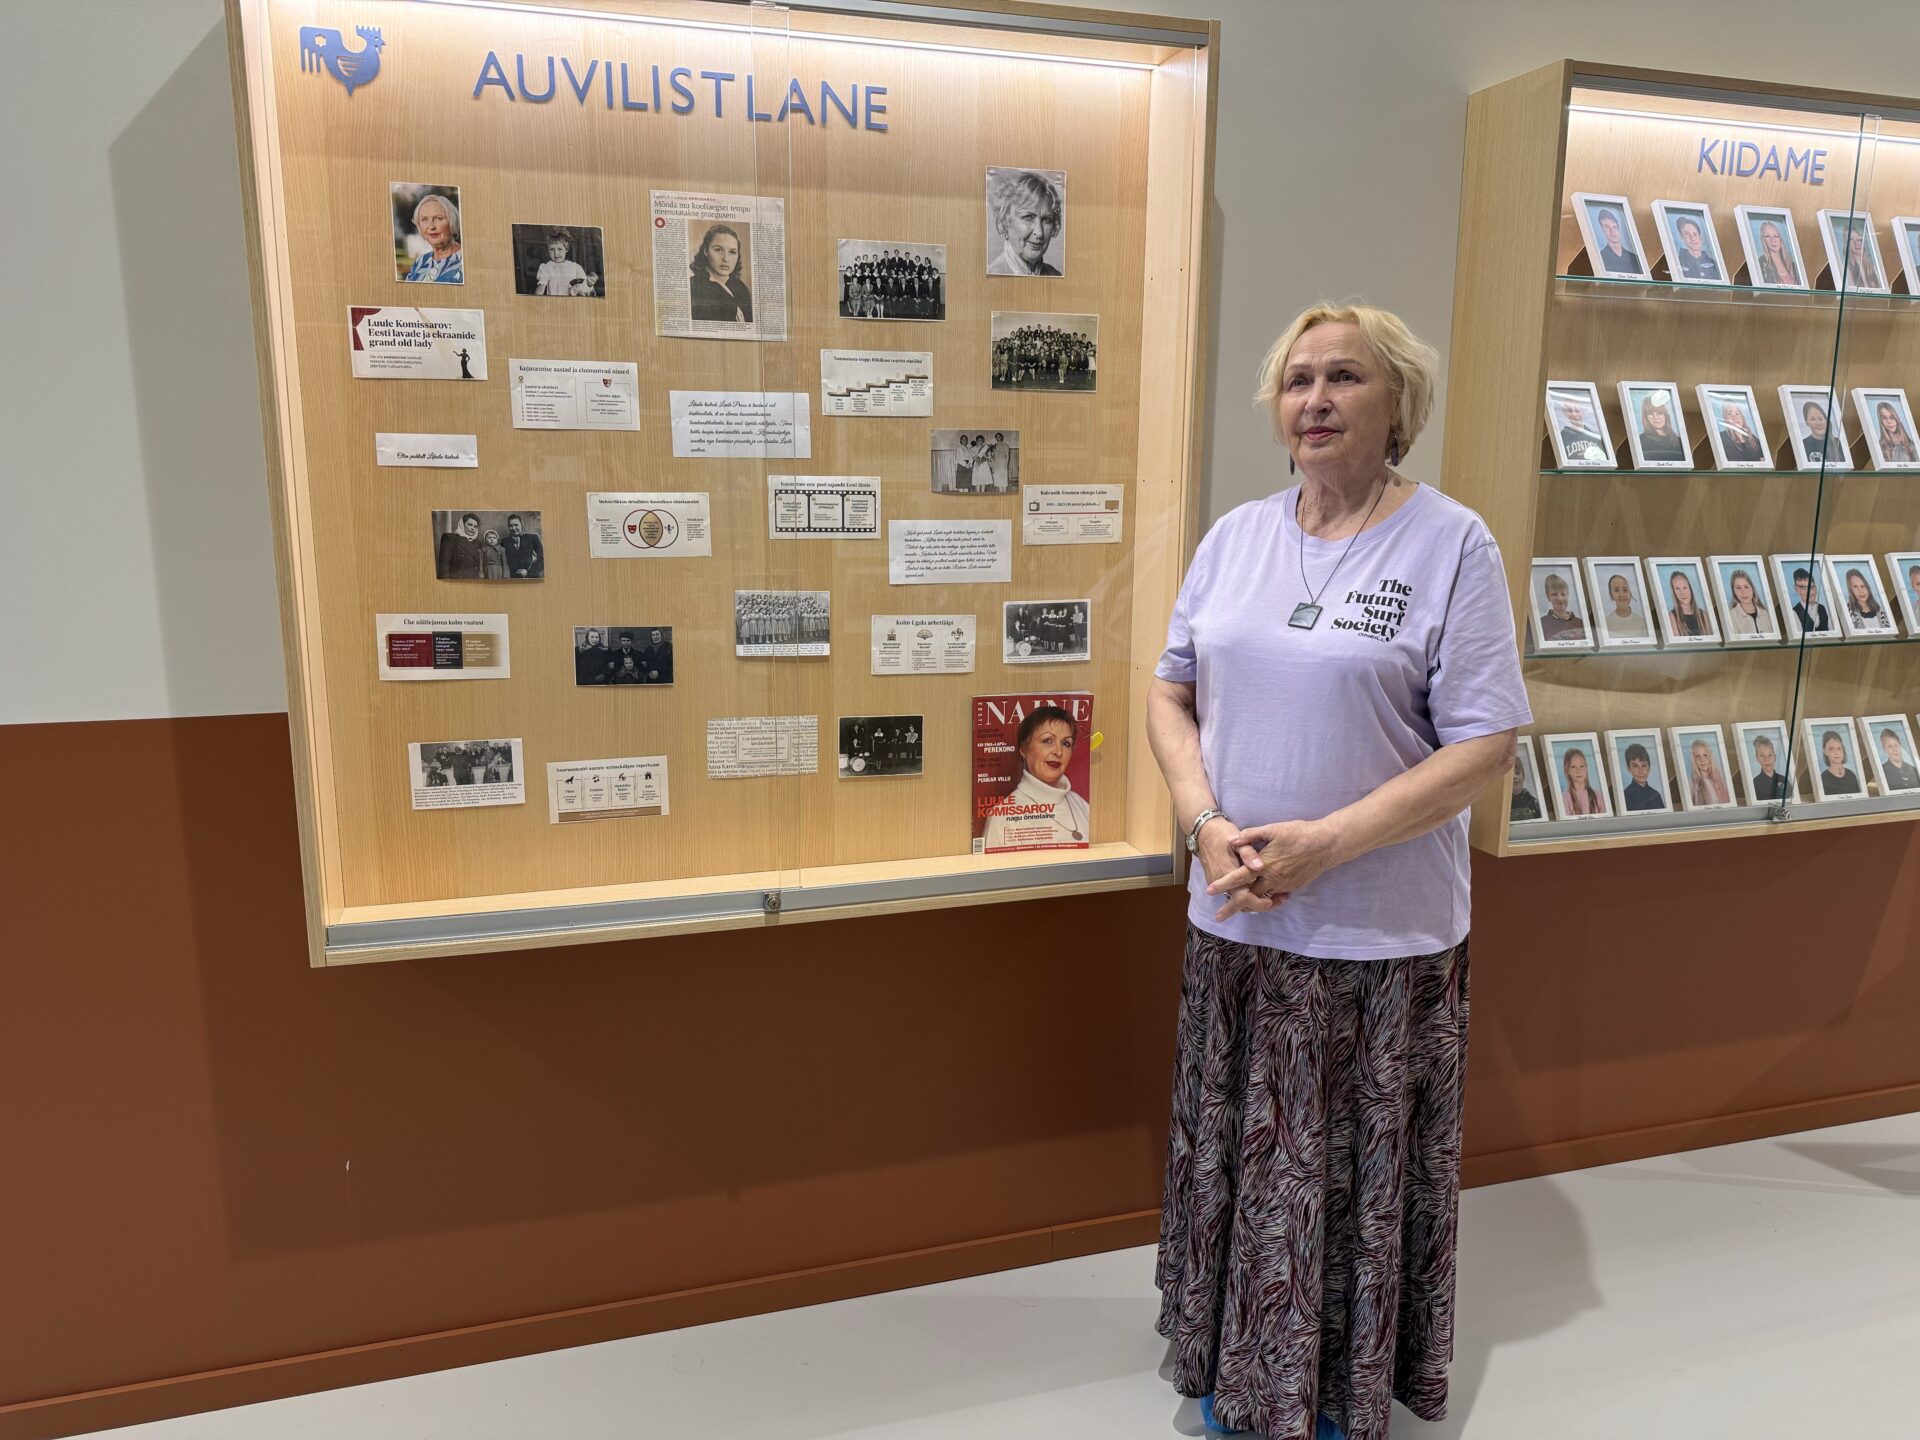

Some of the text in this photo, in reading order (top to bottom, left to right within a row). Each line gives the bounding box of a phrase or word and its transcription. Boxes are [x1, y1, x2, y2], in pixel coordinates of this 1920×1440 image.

[472, 50, 889, 132] AUVILISTLANE
[1697, 137, 1828, 185] KIIDAME
[654, 201, 678, 209] Mõnda
[731, 206, 751, 214] tempu
[701, 209, 736, 220] praeguseni
[368, 319, 452, 330] Luule Komissarov:
[369, 329, 476, 340] Eesti lavade ja ekraanide
[369, 339, 433, 350] grand old lady
[572, 366, 578, 374] ja
[1566, 440, 1599, 457] LOND
[1379, 579, 1413, 597] The
[1344, 590, 1408, 611] Future
[1361, 605, 1405, 627] Surf
[911, 619, 927, 627] Ugala
[1330, 617, 1400, 642] Society
[977, 796, 1016, 807] LUULE
[977, 804, 1056, 818] KOMISSAROV
